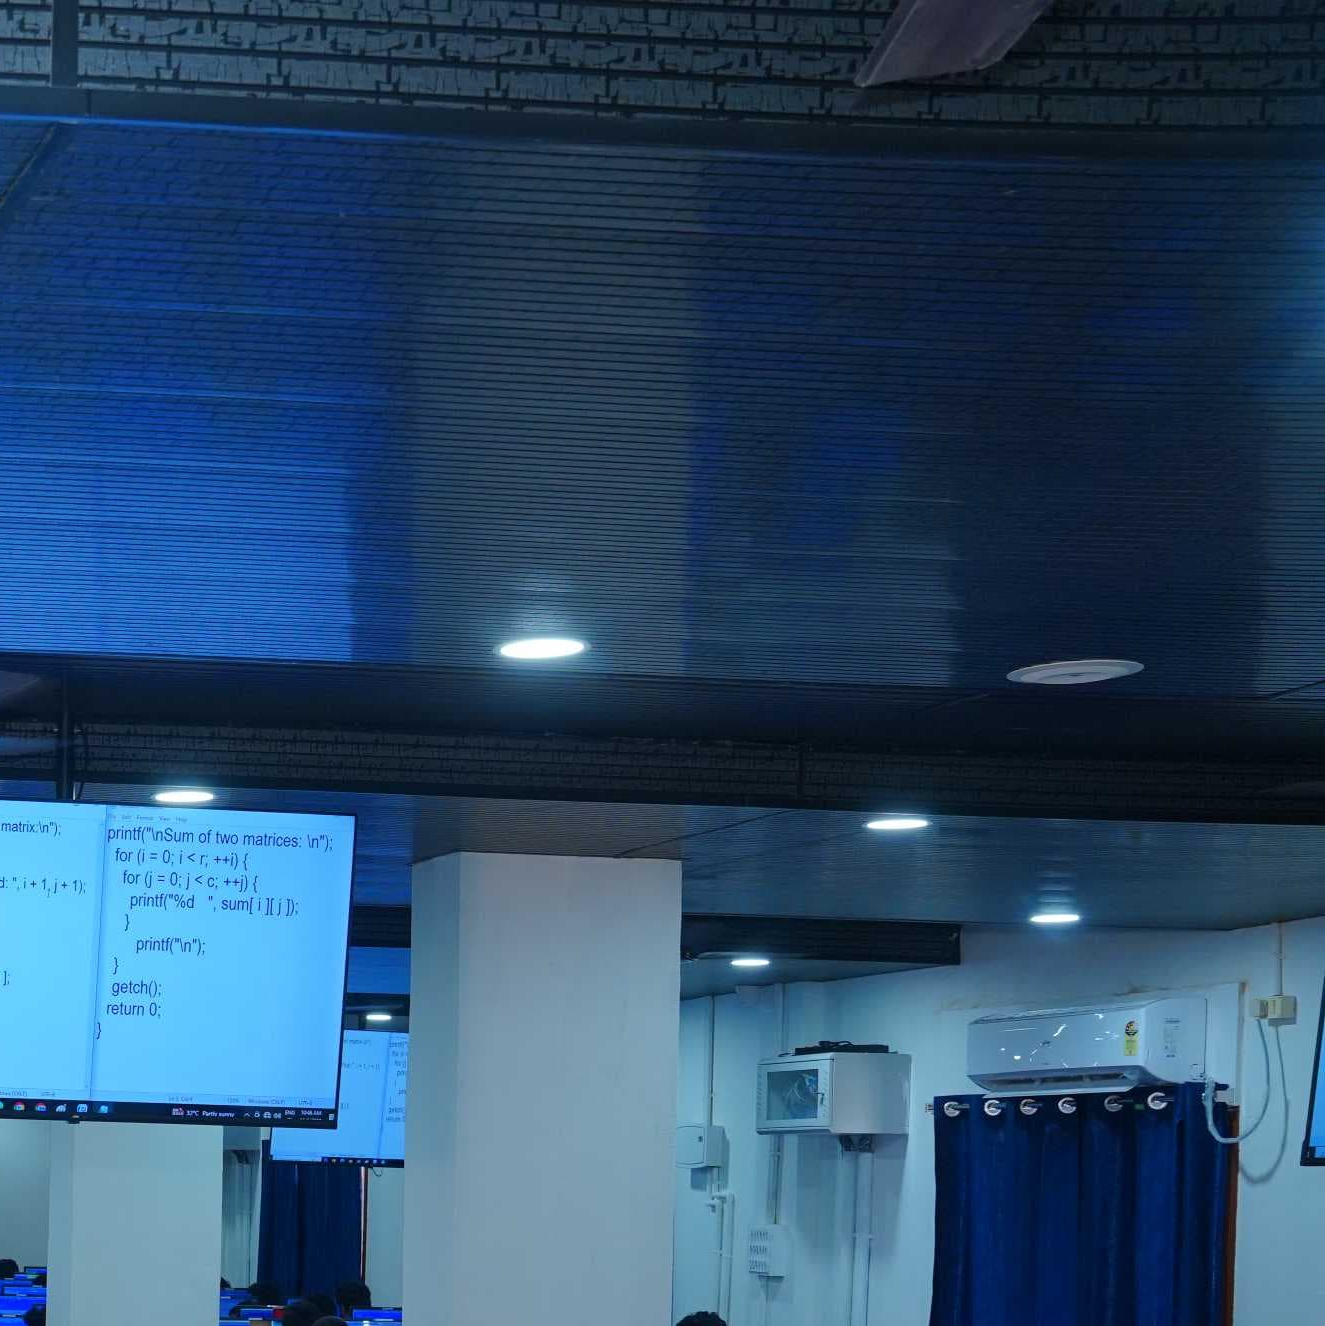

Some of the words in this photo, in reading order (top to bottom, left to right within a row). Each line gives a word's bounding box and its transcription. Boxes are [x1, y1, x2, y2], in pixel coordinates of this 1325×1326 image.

[198, 829, 212, 844] of
[215, 832, 238, 844] two
[243, 833, 301, 847] matrices:
[115, 848, 133, 862] for
[160, 849, 174, 865] 0;
[213, 852, 238, 869] ++i)
[123, 869, 140, 884] for
[170, 872, 181, 887] 0;
[207, 877, 218, 889] c;
[223, 874, 247, 892] ++j)
[221, 897, 253, 914] sum[
[112, 980, 161, 997] getch();
[107, 1002, 144, 1016] return
[149, 1002, 161, 1017] 0;
